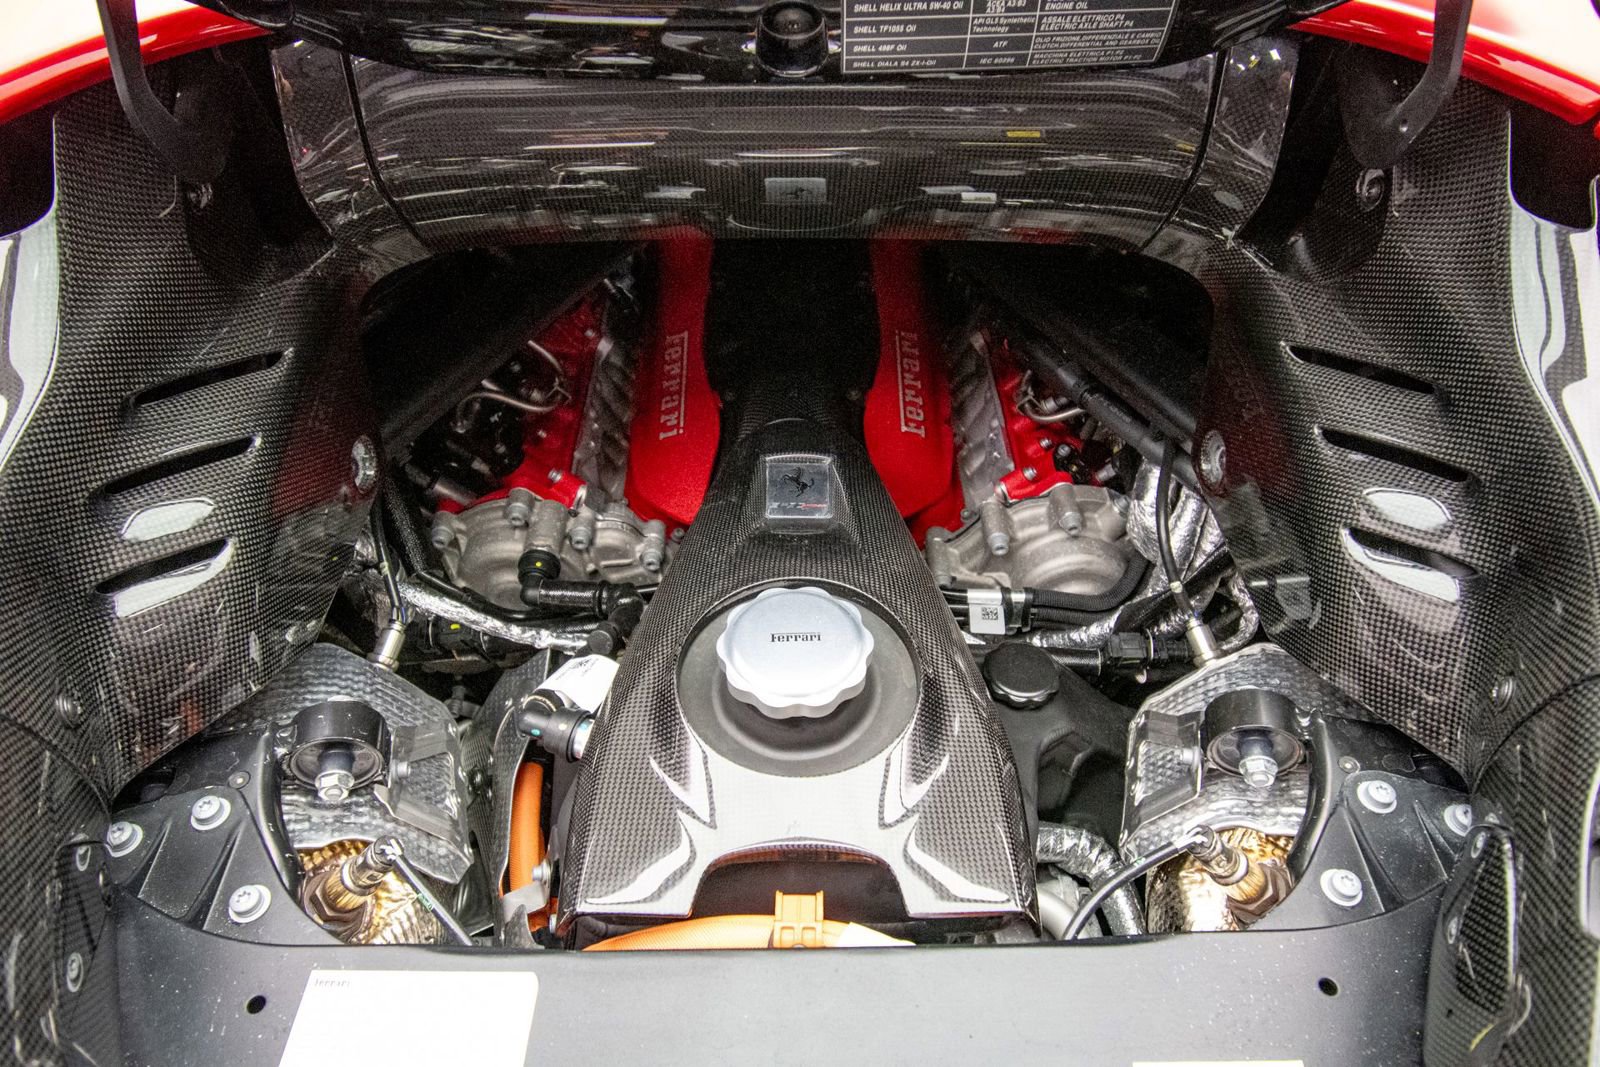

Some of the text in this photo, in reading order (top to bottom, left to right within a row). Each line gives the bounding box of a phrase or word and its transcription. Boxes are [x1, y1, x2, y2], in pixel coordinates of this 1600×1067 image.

[854, 4, 877, 12] SHELL
[879, 3, 902, 12] HELIX
[903, 2, 928, 11] ULTRA
[929, 1, 951, 10] 5W-40
[1045, 1, 1088, 10] ENGINE OIL
[973, 17, 985, 25] API
[1041, 15, 1072, 23] ASSALE
[1072, 14, 1115, 22] ELETTRICO
[853, 25, 877, 34] SHELL
[972, 25, 1009, 33] Technology
[1040, 22, 1077, 31] ELECTRIC
[1098, 20, 1124, 29] SHAFT
[992, 40, 1009, 48] ATF
[658, 330, 689, 440] Ferrari
[895, 330, 926, 439] Ferrari
[770, 632, 822, 643] Ferrari
